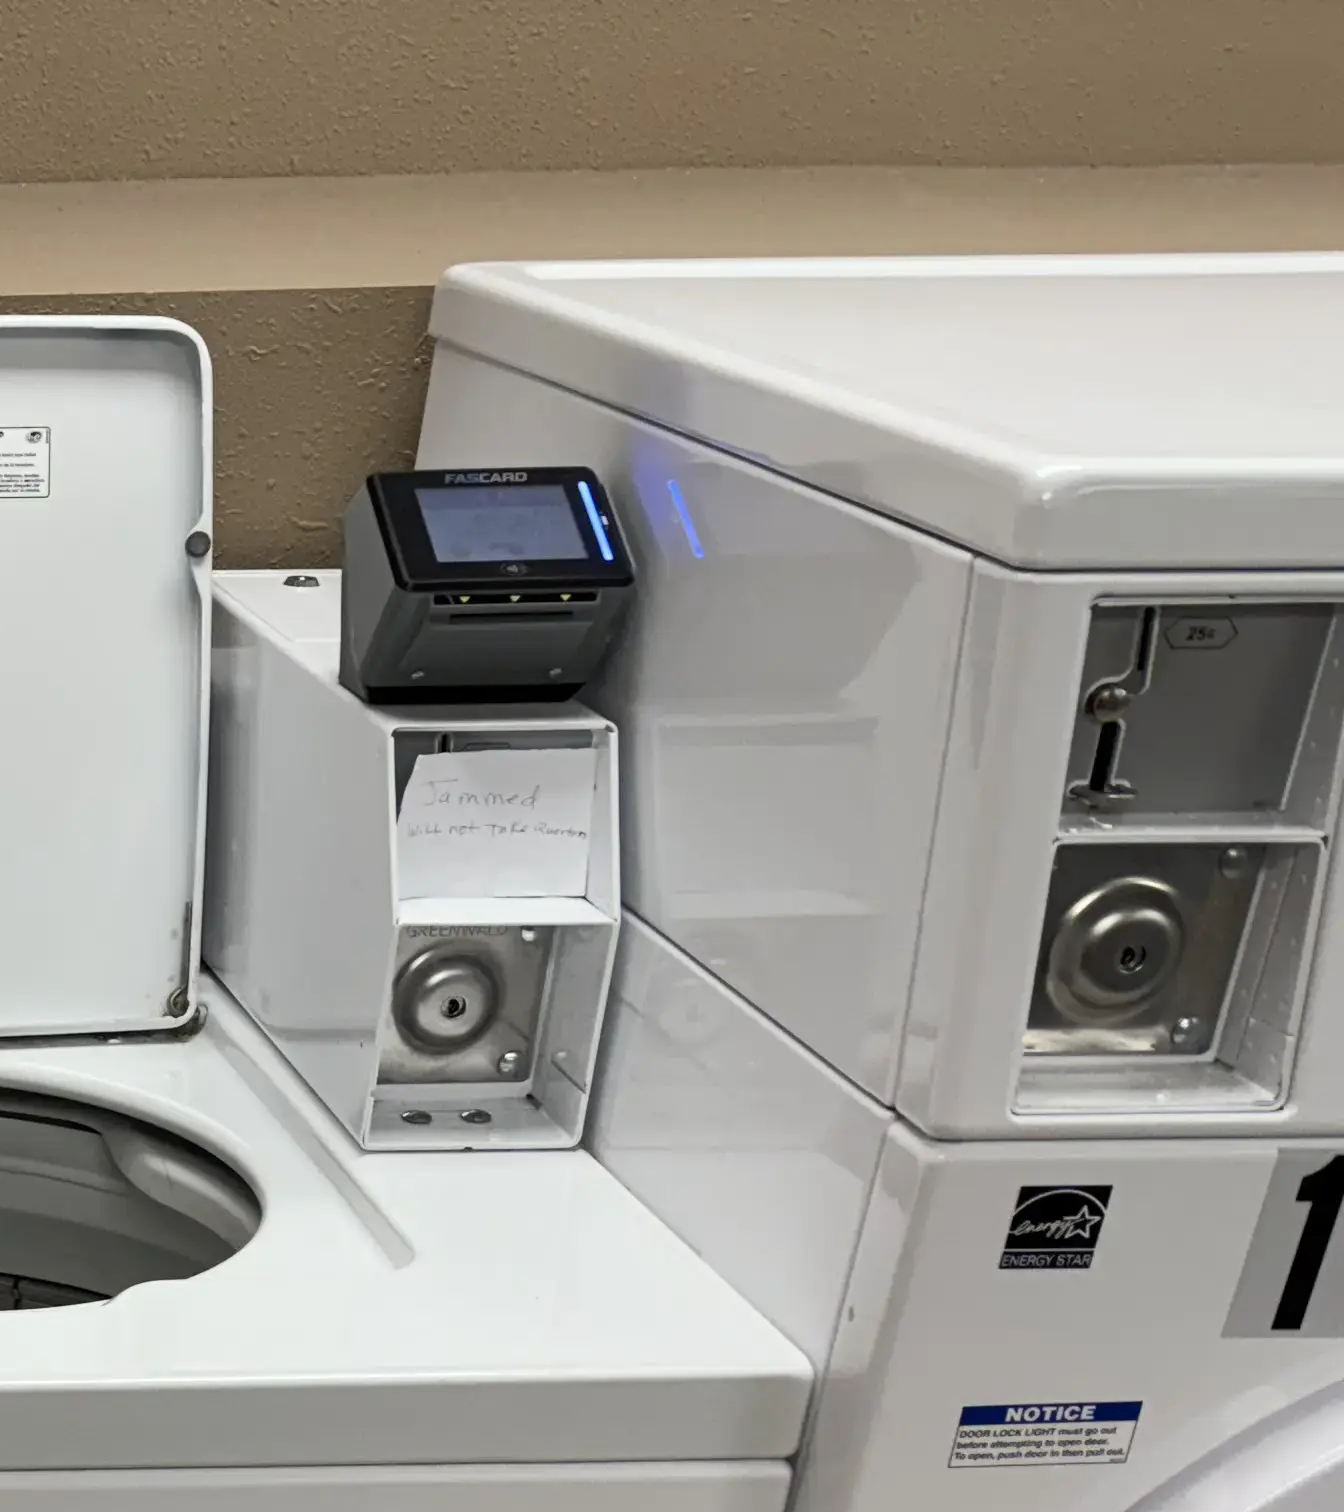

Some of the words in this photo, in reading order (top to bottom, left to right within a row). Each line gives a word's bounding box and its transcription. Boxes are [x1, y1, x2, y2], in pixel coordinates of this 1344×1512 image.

[444, 472, 528, 484] FASCARD
[422, 778, 541, 809] Jammed
[1270, 1154, 1344, 1330] 1
[1001, 1254, 1054, 1266] ENERGY
[1055, 1253, 1092, 1266] STAR
[1005, 1405, 1097, 1422] NOTICE
[960, 1429, 991, 1438] DOOR
[993, 1429, 1021, 1437] LOCK
[1025, 1428, 1056, 1436] LIGHT
[1058, 1427, 1083, 1435] must
[1085, 1428, 1098, 1436] go
[957, 1441, 988, 1449] before
[991, 1440, 1042, 1449] attempting
[1084, 1438, 1110, 1446] door.
[955, 1452, 966, 1460] To
[968, 1452, 995, 1461] open,
[997, 1450, 1022, 1460] push
[1024, 1450, 1048, 1458] door
[1085, 1448, 1105, 1457] pull
[1106, 1447, 1125, 1456] out.
